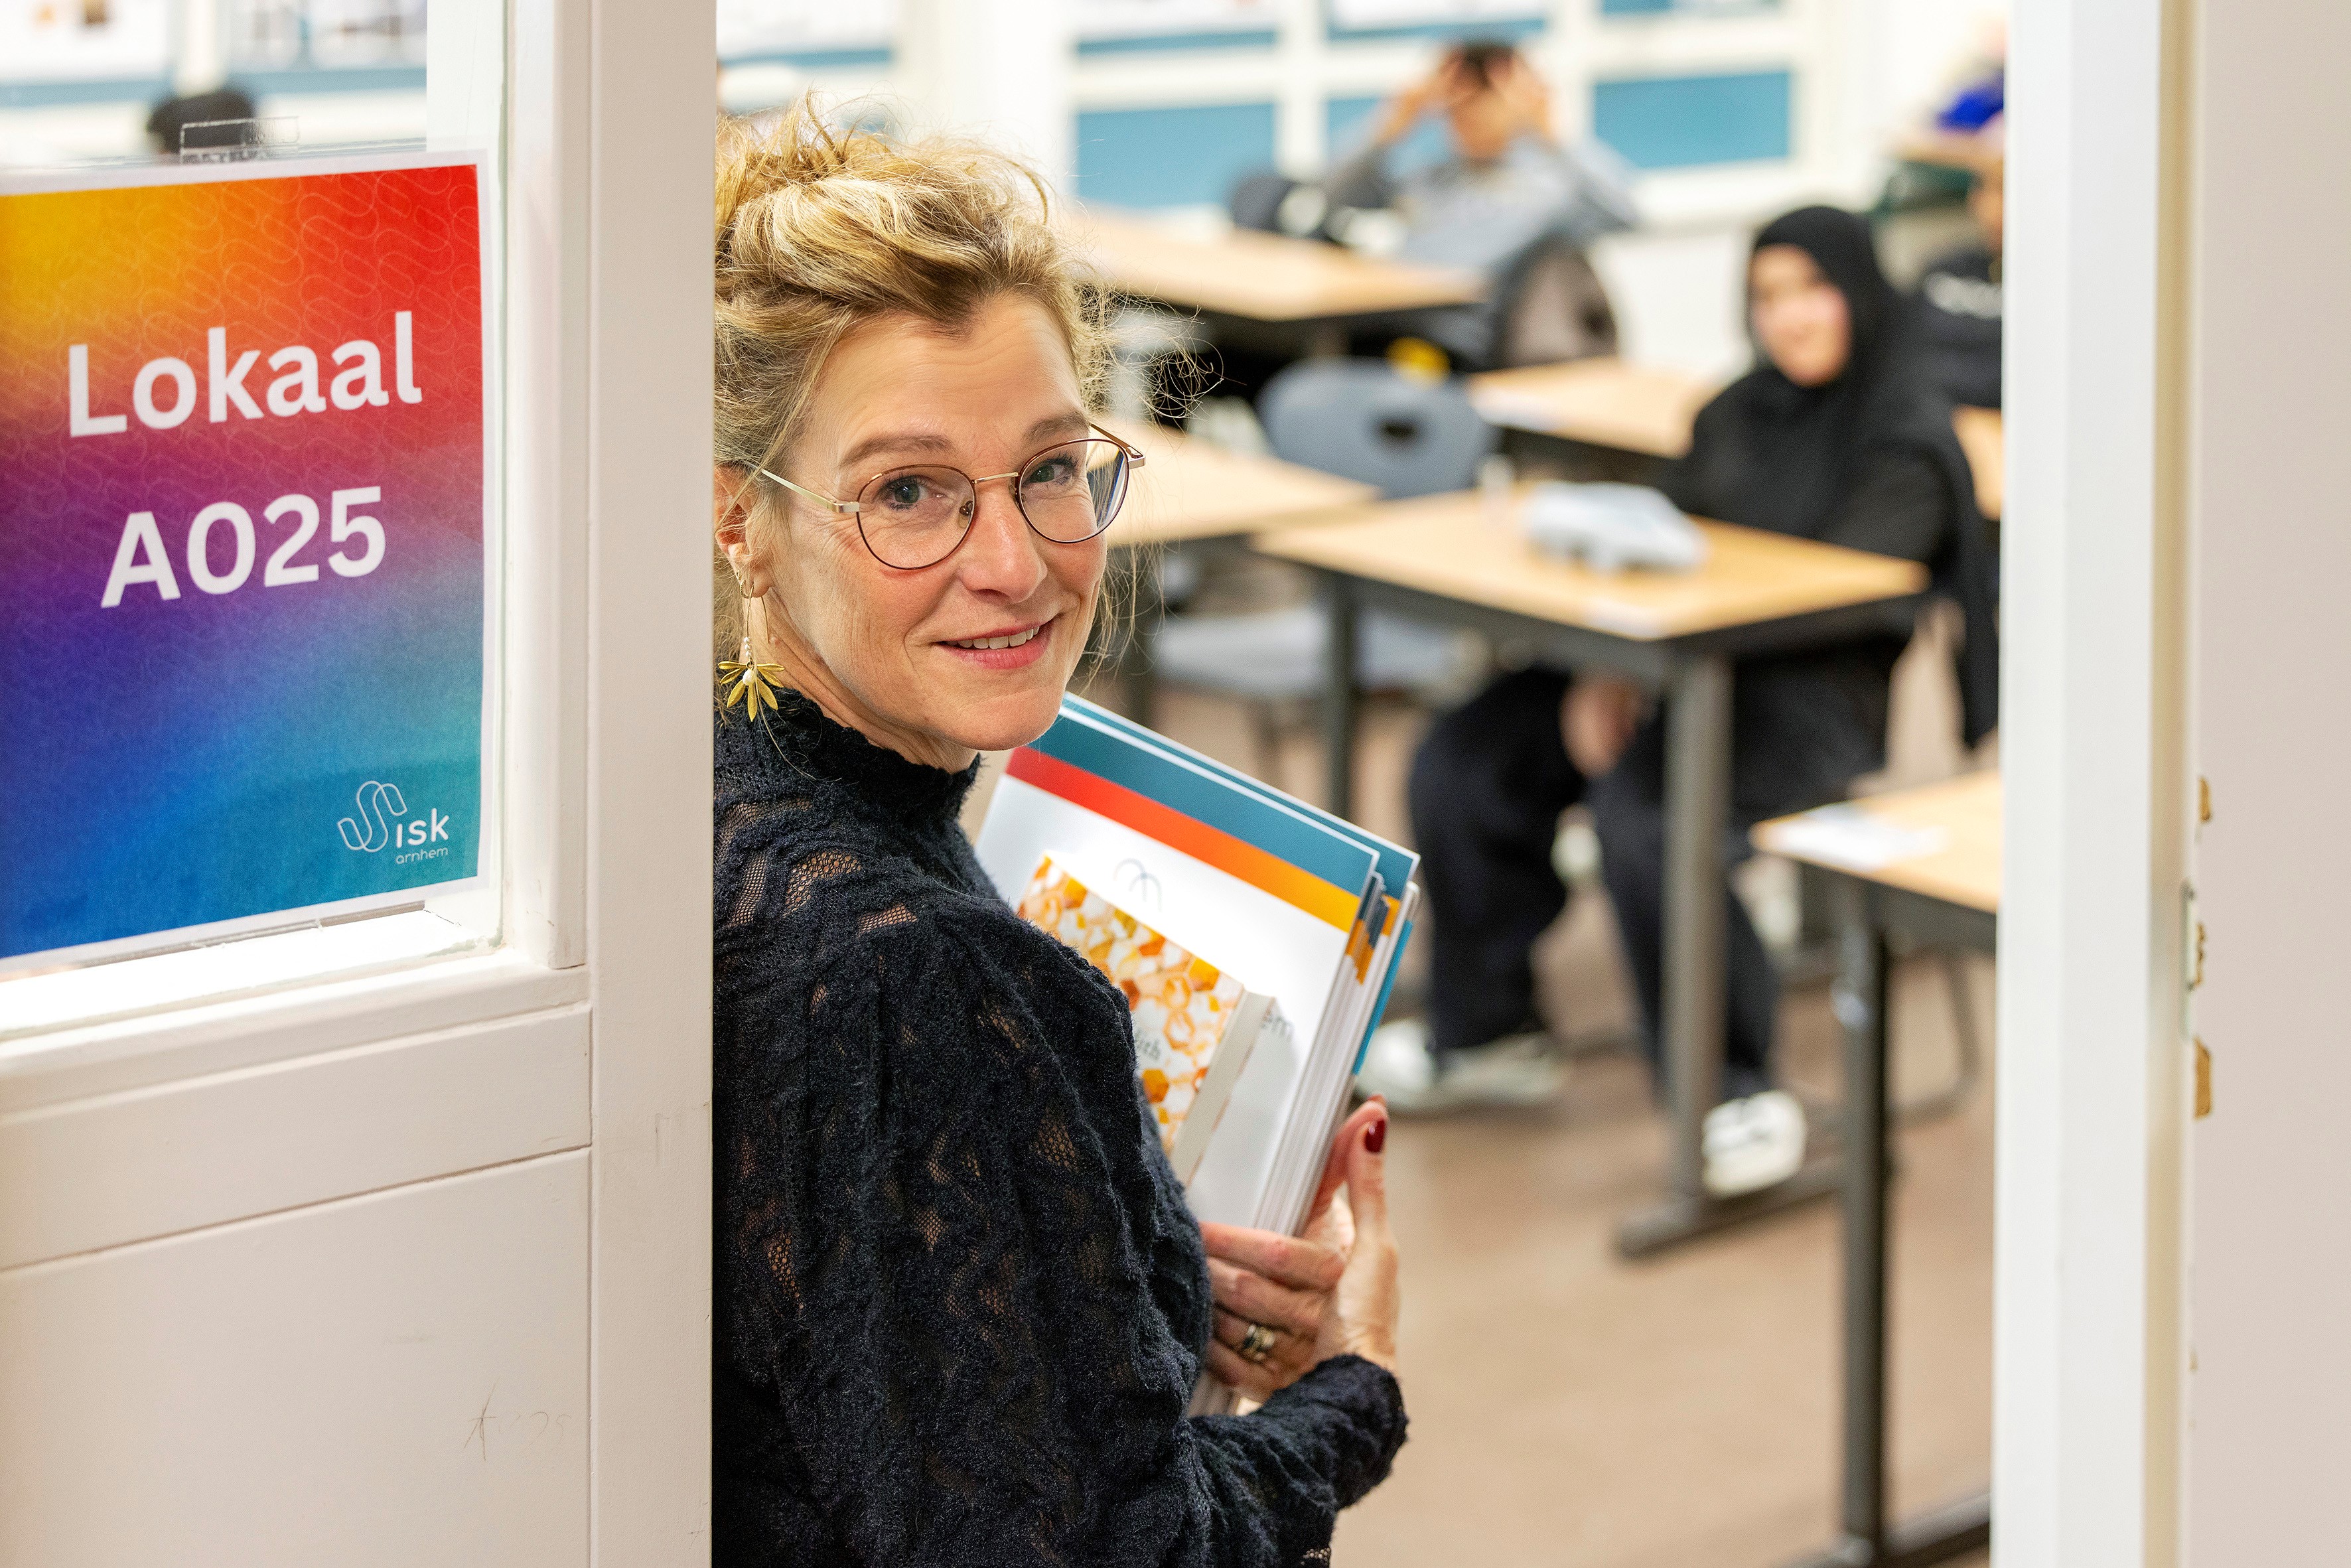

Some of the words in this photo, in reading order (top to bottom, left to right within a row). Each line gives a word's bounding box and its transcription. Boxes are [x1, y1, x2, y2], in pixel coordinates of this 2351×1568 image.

[69, 311, 423, 437] Lokaal
[101, 486, 386, 608] A025
[395, 847, 449, 865] arnhem
[396, 808, 450, 849] isk
